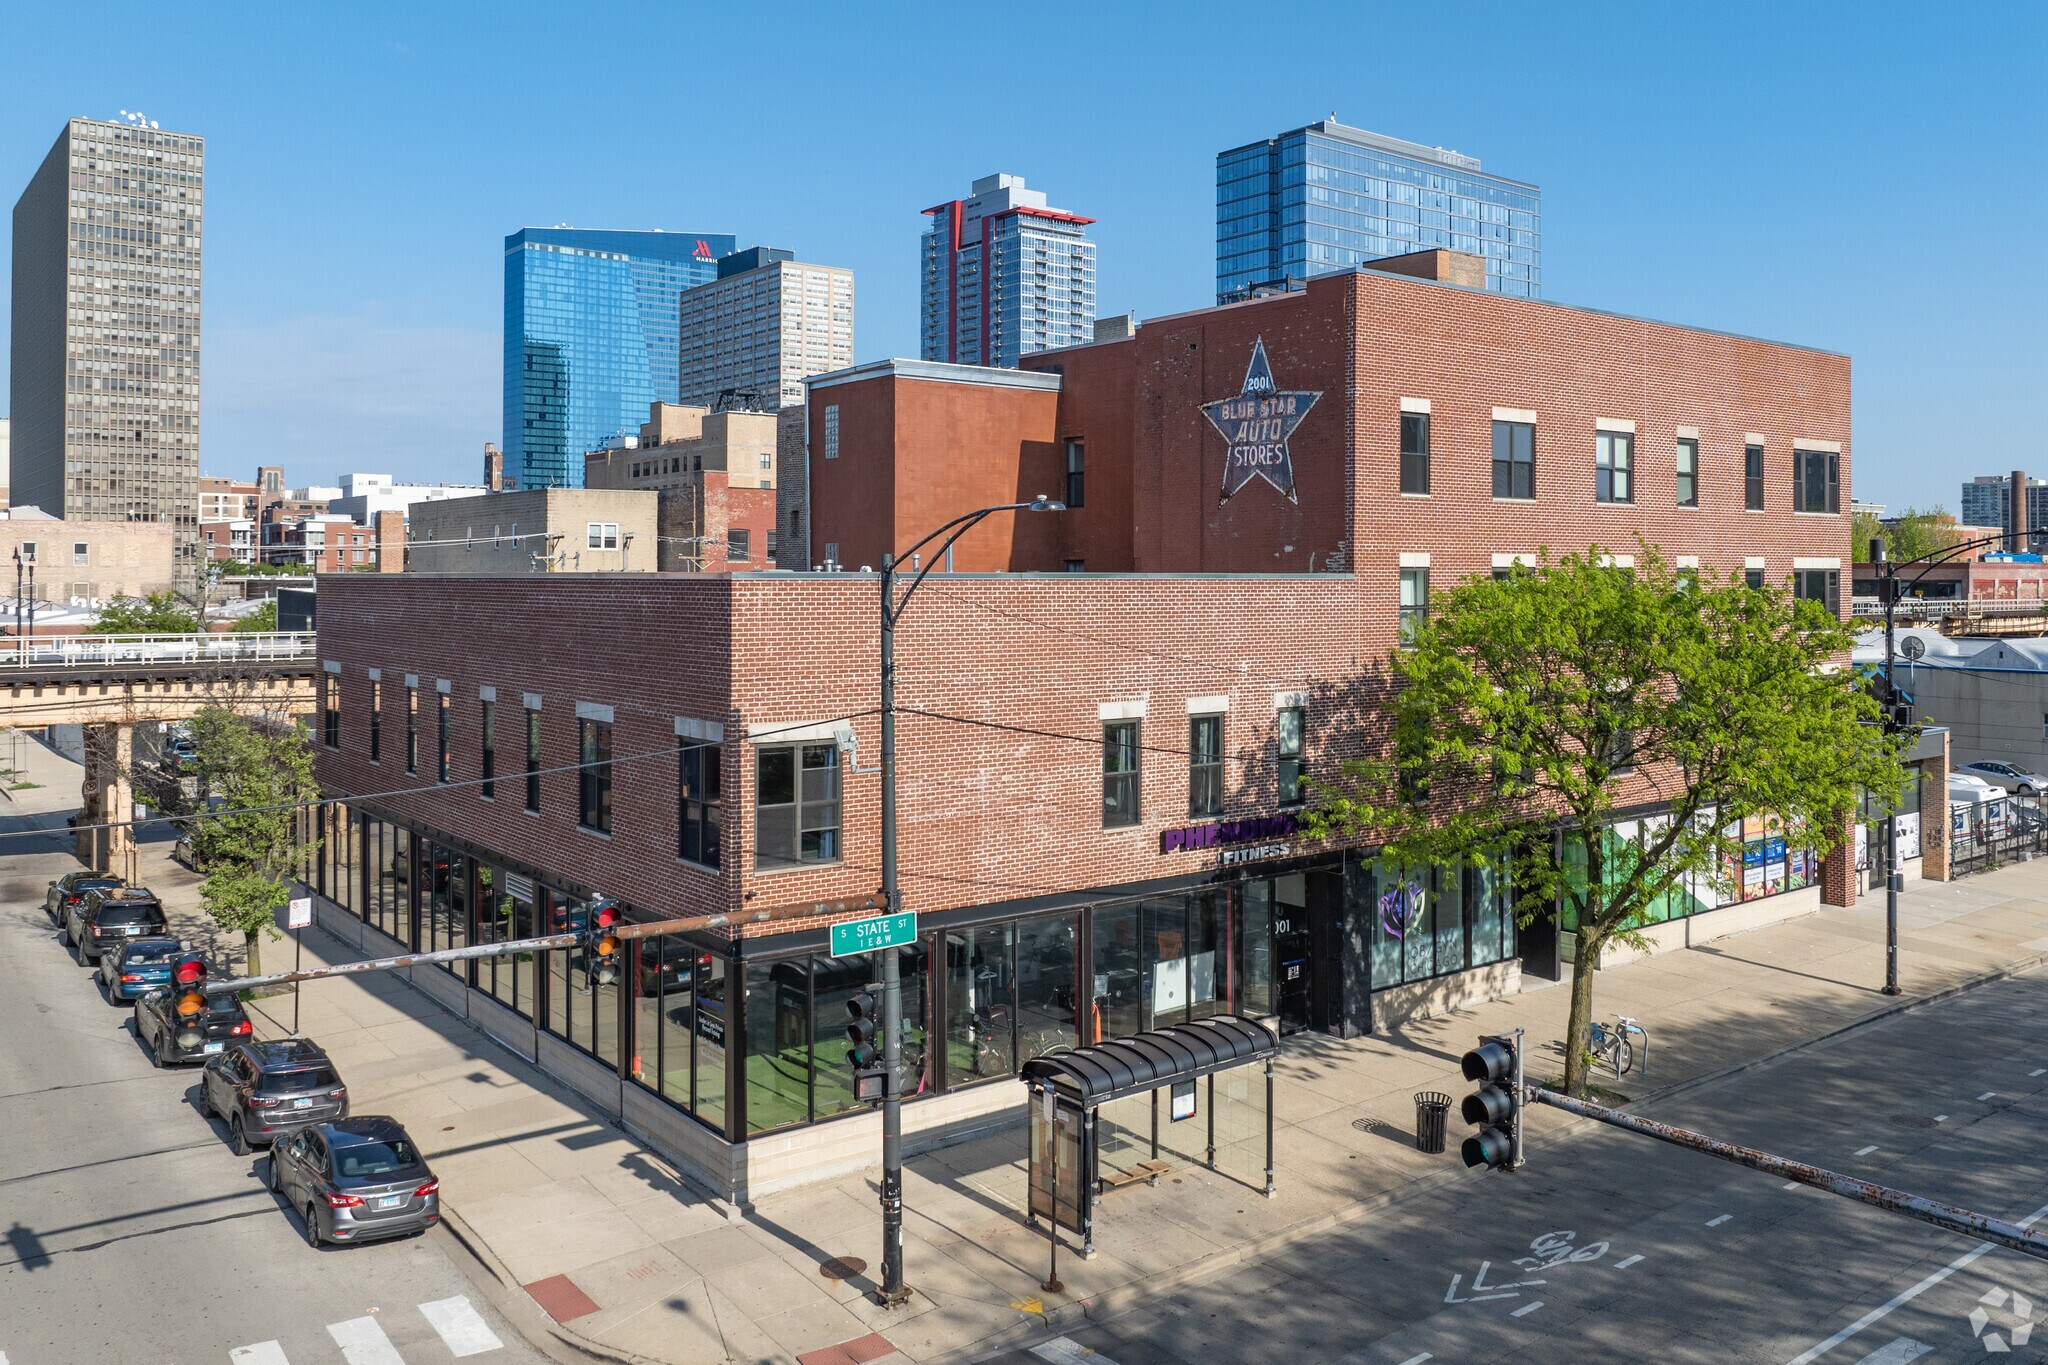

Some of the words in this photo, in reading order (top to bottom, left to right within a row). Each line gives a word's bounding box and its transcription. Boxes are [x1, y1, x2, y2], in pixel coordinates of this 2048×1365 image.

[1248, 376, 1269, 391] 2001
[1222, 401, 1255, 420] BLUE
[1261, 397, 1296, 416] STAR
[1234, 419, 1282, 442] AUTO
[1234, 444, 1283, 467] STORES
[1219, 843, 1290, 865] FITNESS
[841, 929, 847, 938] S
[857, 920, 890, 937] STATE
[898, 919, 907, 928] ST
